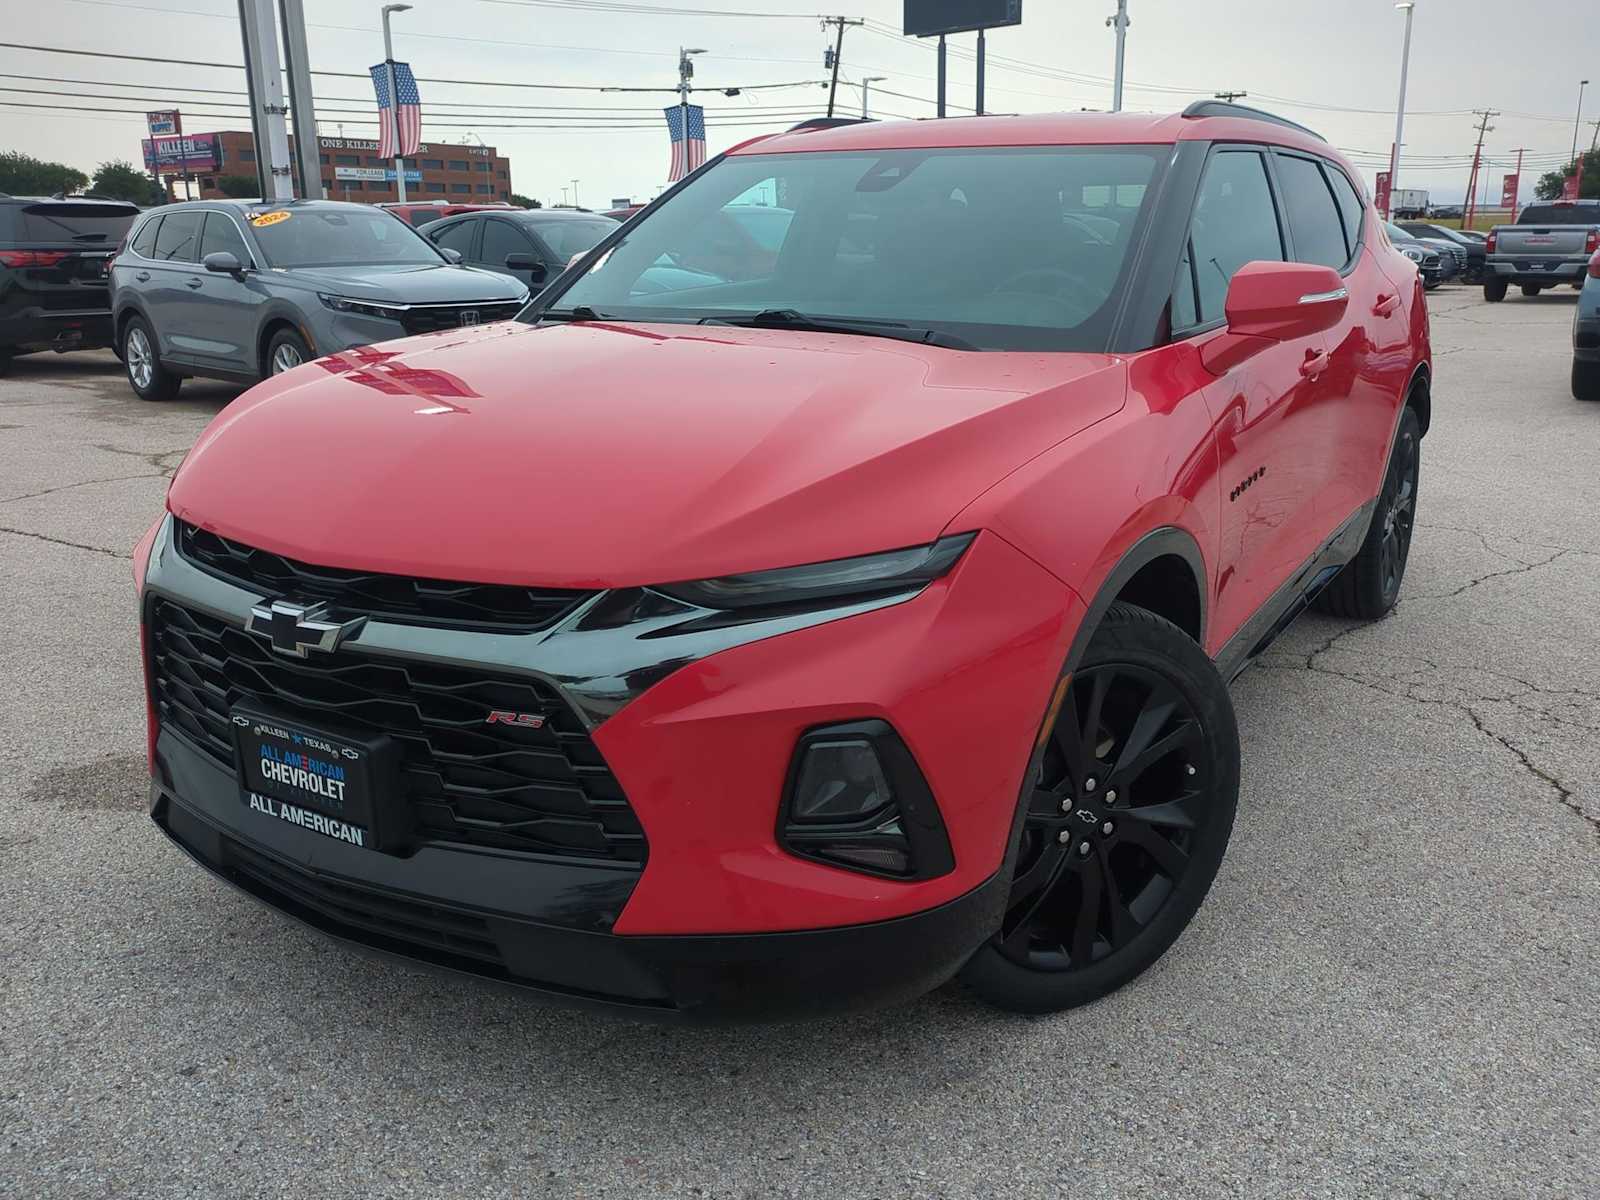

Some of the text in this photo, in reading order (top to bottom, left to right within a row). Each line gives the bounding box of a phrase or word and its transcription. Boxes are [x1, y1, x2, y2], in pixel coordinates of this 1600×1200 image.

[160, 139, 195, 154] KILLEEN
[321, 139, 383, 151] ONE KILLEE
[256, 211, 288, 225] 2024
[485, 710, 545, 729] RS
[259, 725, 332, 753] KILLEEN TEXAS
[260, 744, 345, 781] ALL AMERICAN
[261, 758, 345, 801] CHEVROLET
[250, 793, 363, 847] ALL AMERICAN
